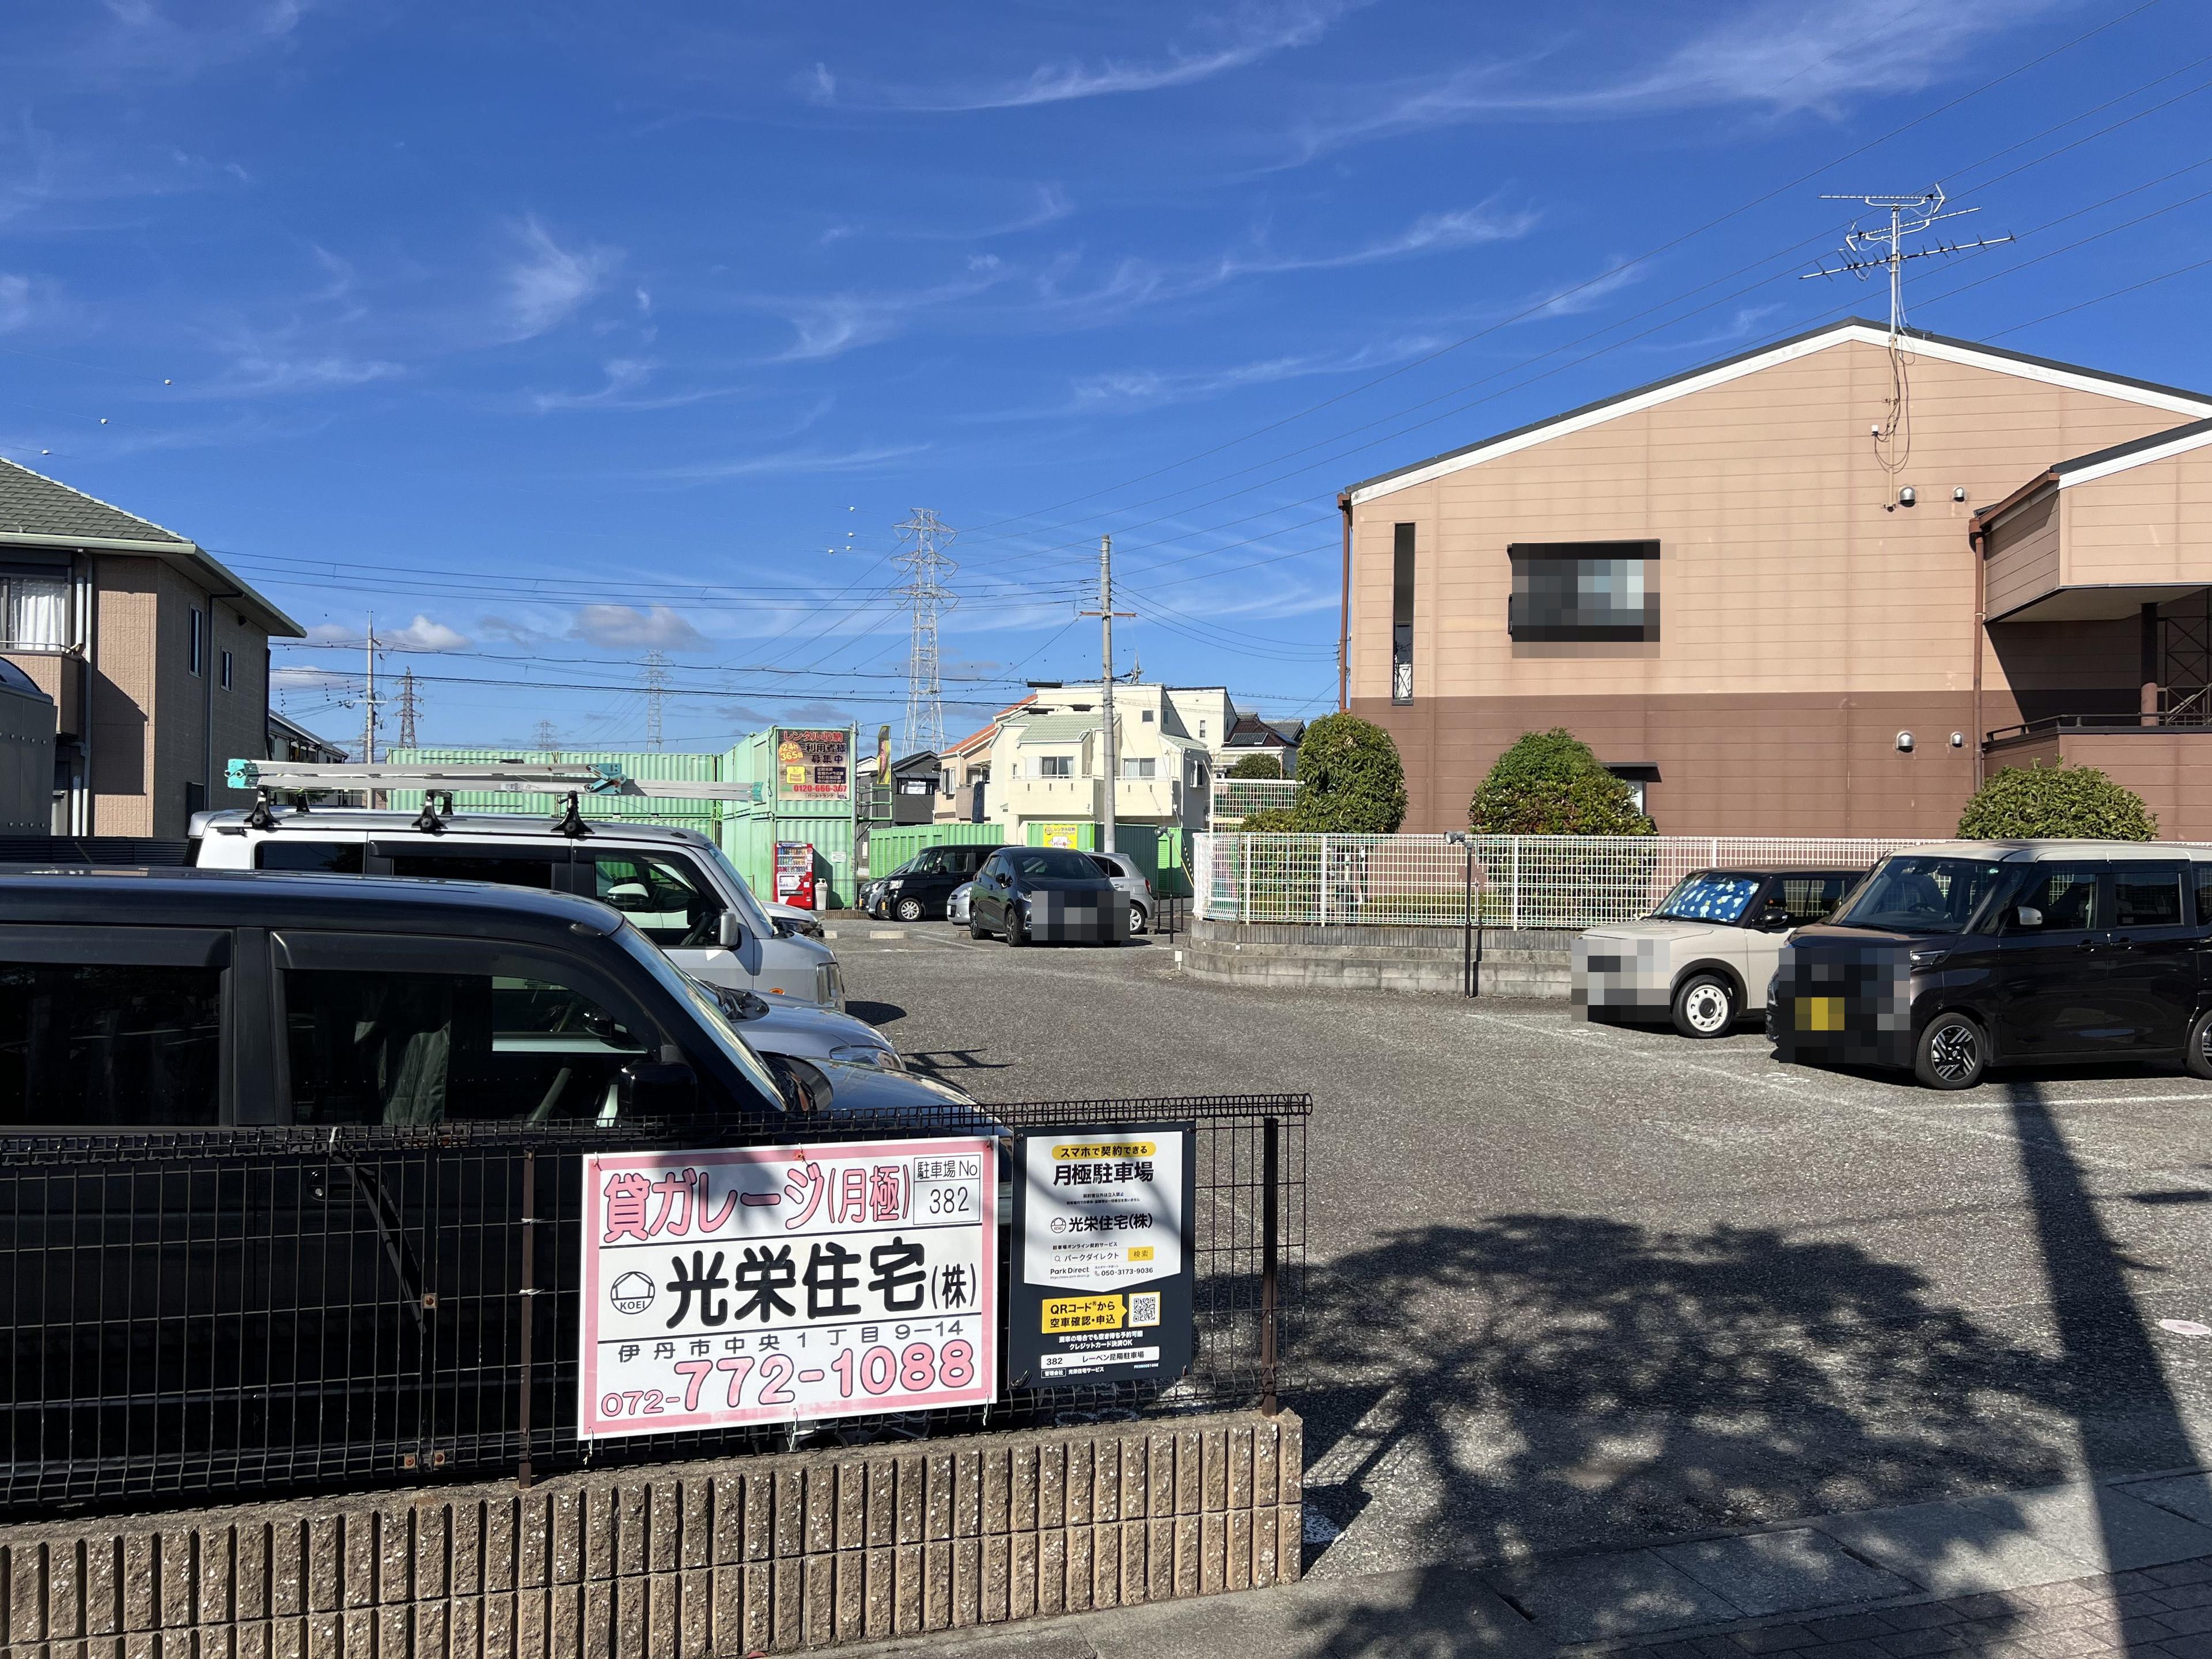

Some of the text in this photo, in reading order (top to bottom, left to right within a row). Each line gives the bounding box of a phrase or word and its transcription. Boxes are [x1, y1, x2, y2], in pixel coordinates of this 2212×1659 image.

[783, 730, 843, 742] レンタル収納
[782, 743, 798, 752] 24h
[781, 751, 804, 761] 365日
[812, 755, 843, 763] 募集中
[1060, 1145, 1147, 1158] スマホで契約できる
[1053, 1161, 1154, 1186] 月極駐車場
[930, 1187, 969, 1214] 382
[1052, 1242, 1118, 1251] 駐車場オンライン契約サービス
[1065, 1250, 1149, 1262] パークダイレクト 検索
[1101, 1267, 1153, 1276] 050-3173-9036
[620, 1300, 646, 1310] KOEI
[1069, 1339, 1133, 1350] クレジットカード決済OK
[1046, 1357, 1063, 1365] 382
[1082, 1351, 1144, 1363] レーベン昆陽駐車場
[601, 1339, 974, 1417] 072-772-1088
